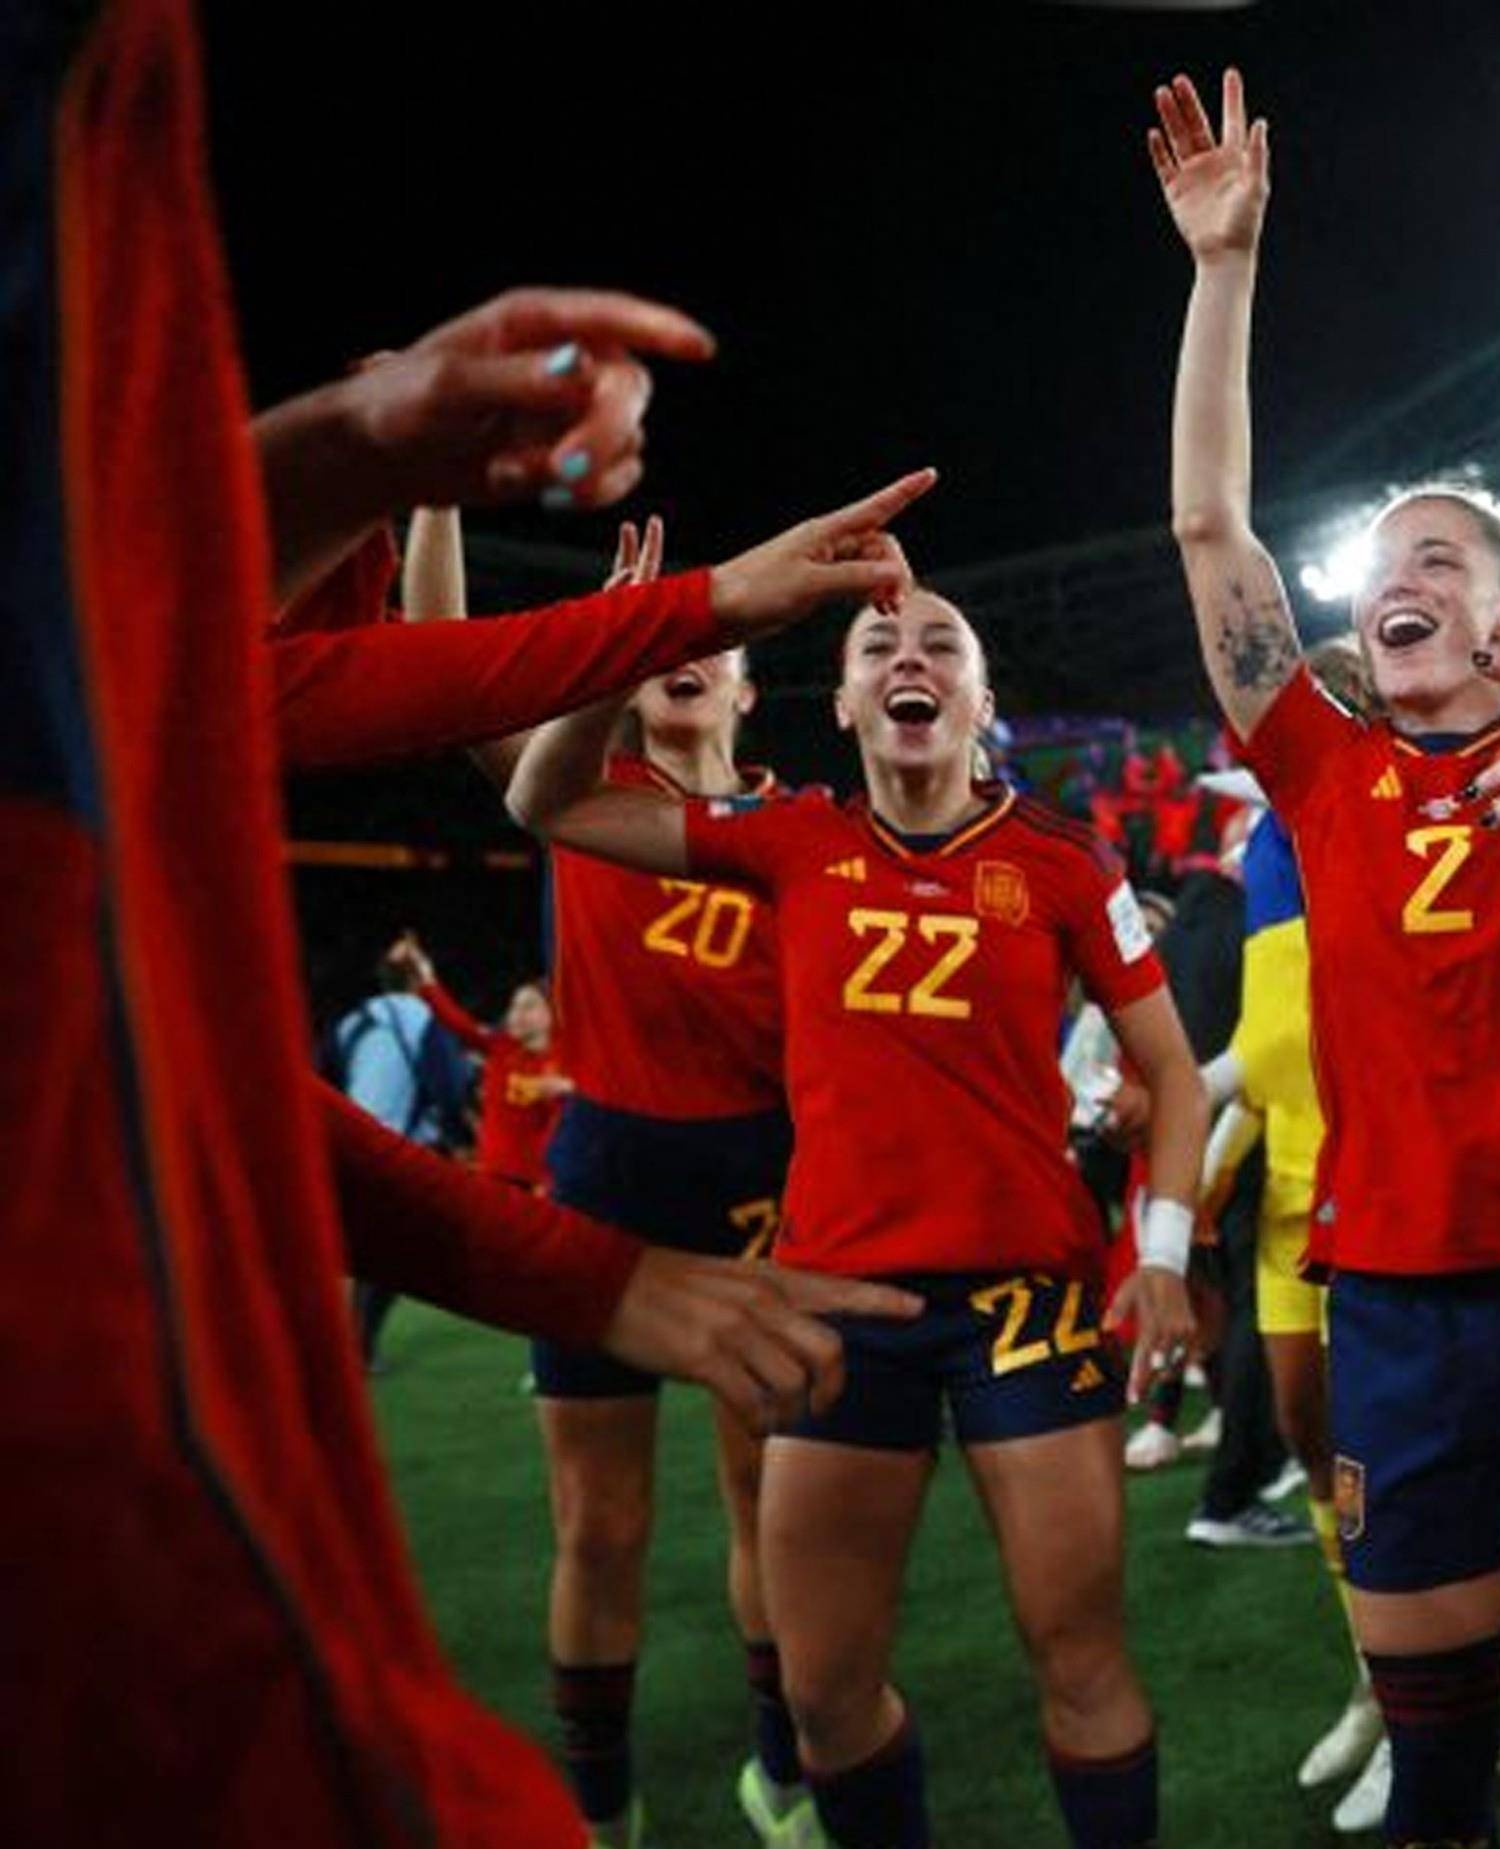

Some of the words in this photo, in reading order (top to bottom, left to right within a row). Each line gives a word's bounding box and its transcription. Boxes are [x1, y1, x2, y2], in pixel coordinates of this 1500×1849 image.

[644, 877, 755, 967] 20
[1402, 825, 1473, 933] 2
[844, 908, 981, 1020] 22
